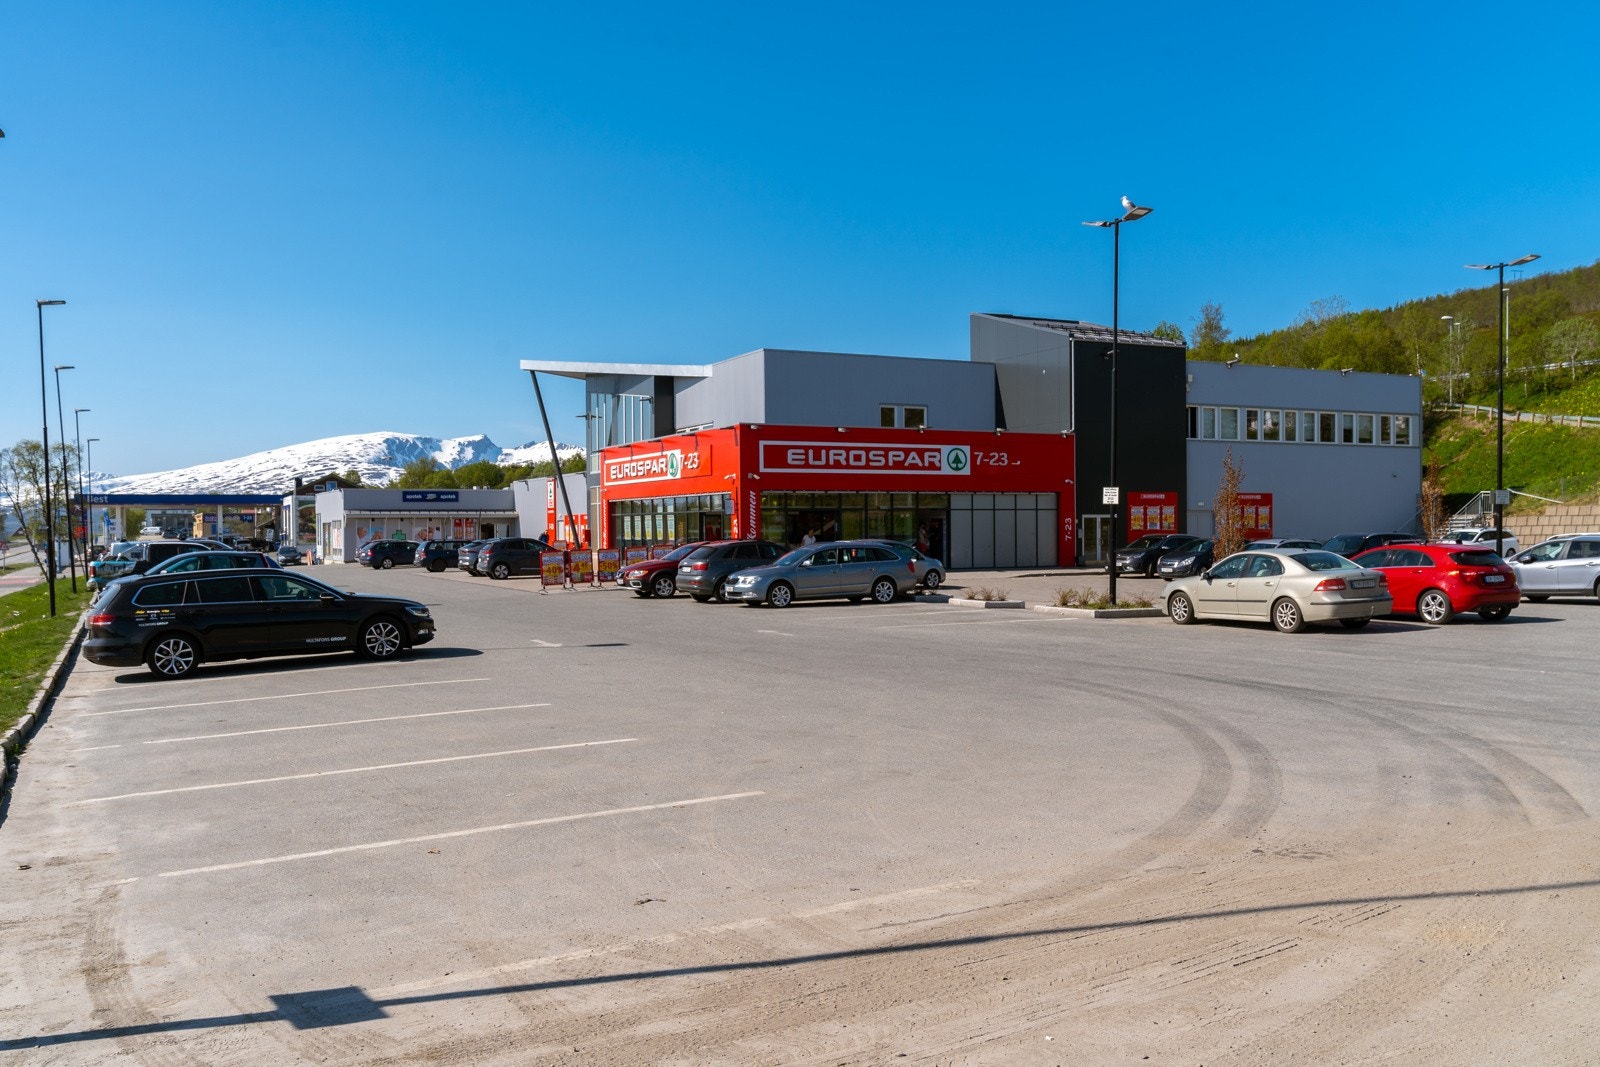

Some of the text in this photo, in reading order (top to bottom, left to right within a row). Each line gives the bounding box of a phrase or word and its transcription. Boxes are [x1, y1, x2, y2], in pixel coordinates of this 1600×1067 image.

[610, 452, 699, 480] EUROSPAR 7-23
[787, 449, 1008, 467] EUROSPAR 7-23
[747, 491, 756, 541] kommen
